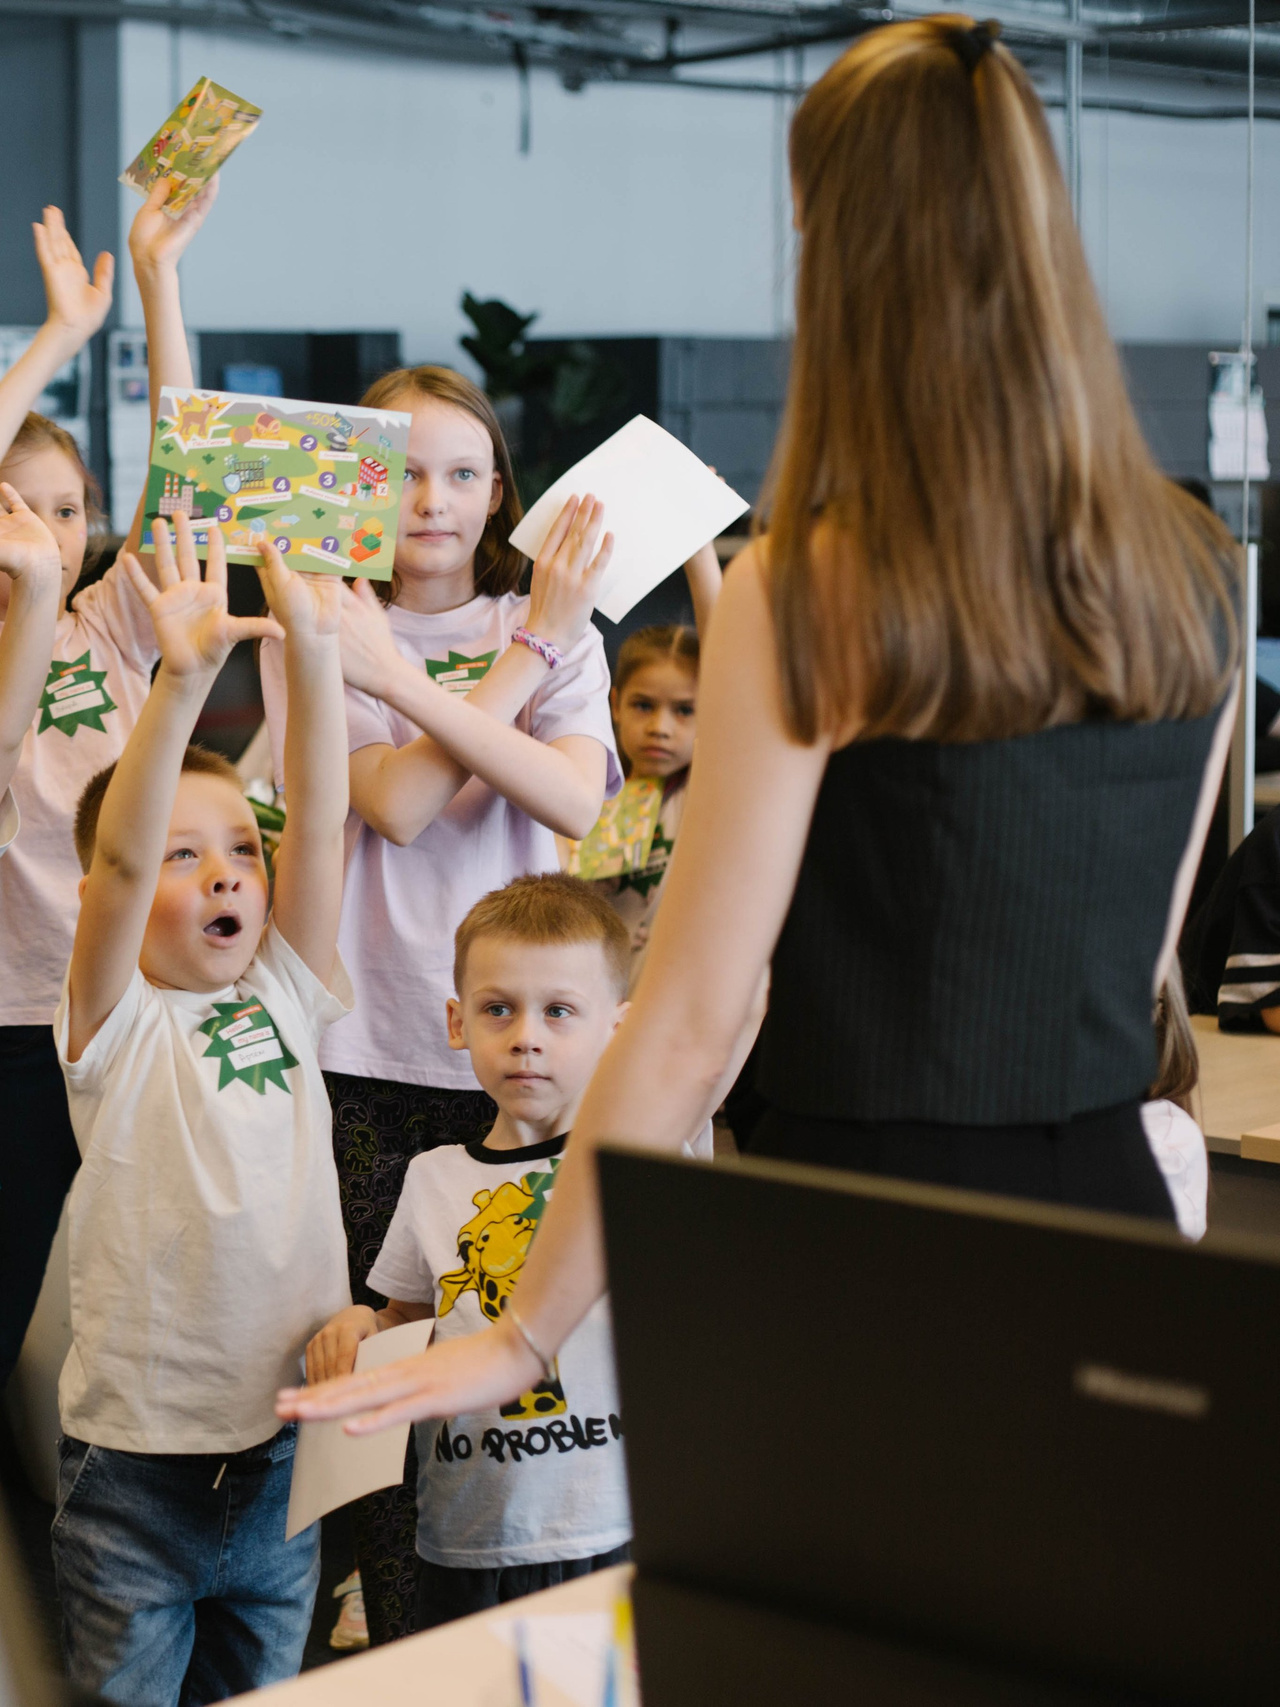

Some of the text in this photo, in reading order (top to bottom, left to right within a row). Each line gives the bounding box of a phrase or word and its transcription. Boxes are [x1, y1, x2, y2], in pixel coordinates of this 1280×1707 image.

[303, 437, 314, 449] 2
[276, 479, 287, 491] 4
[323, 473, 333, 486] 3
[219, 508, 229, 519] 5
[277, 539, 287, 550] 6
[325, 539, 335, 551] 7
